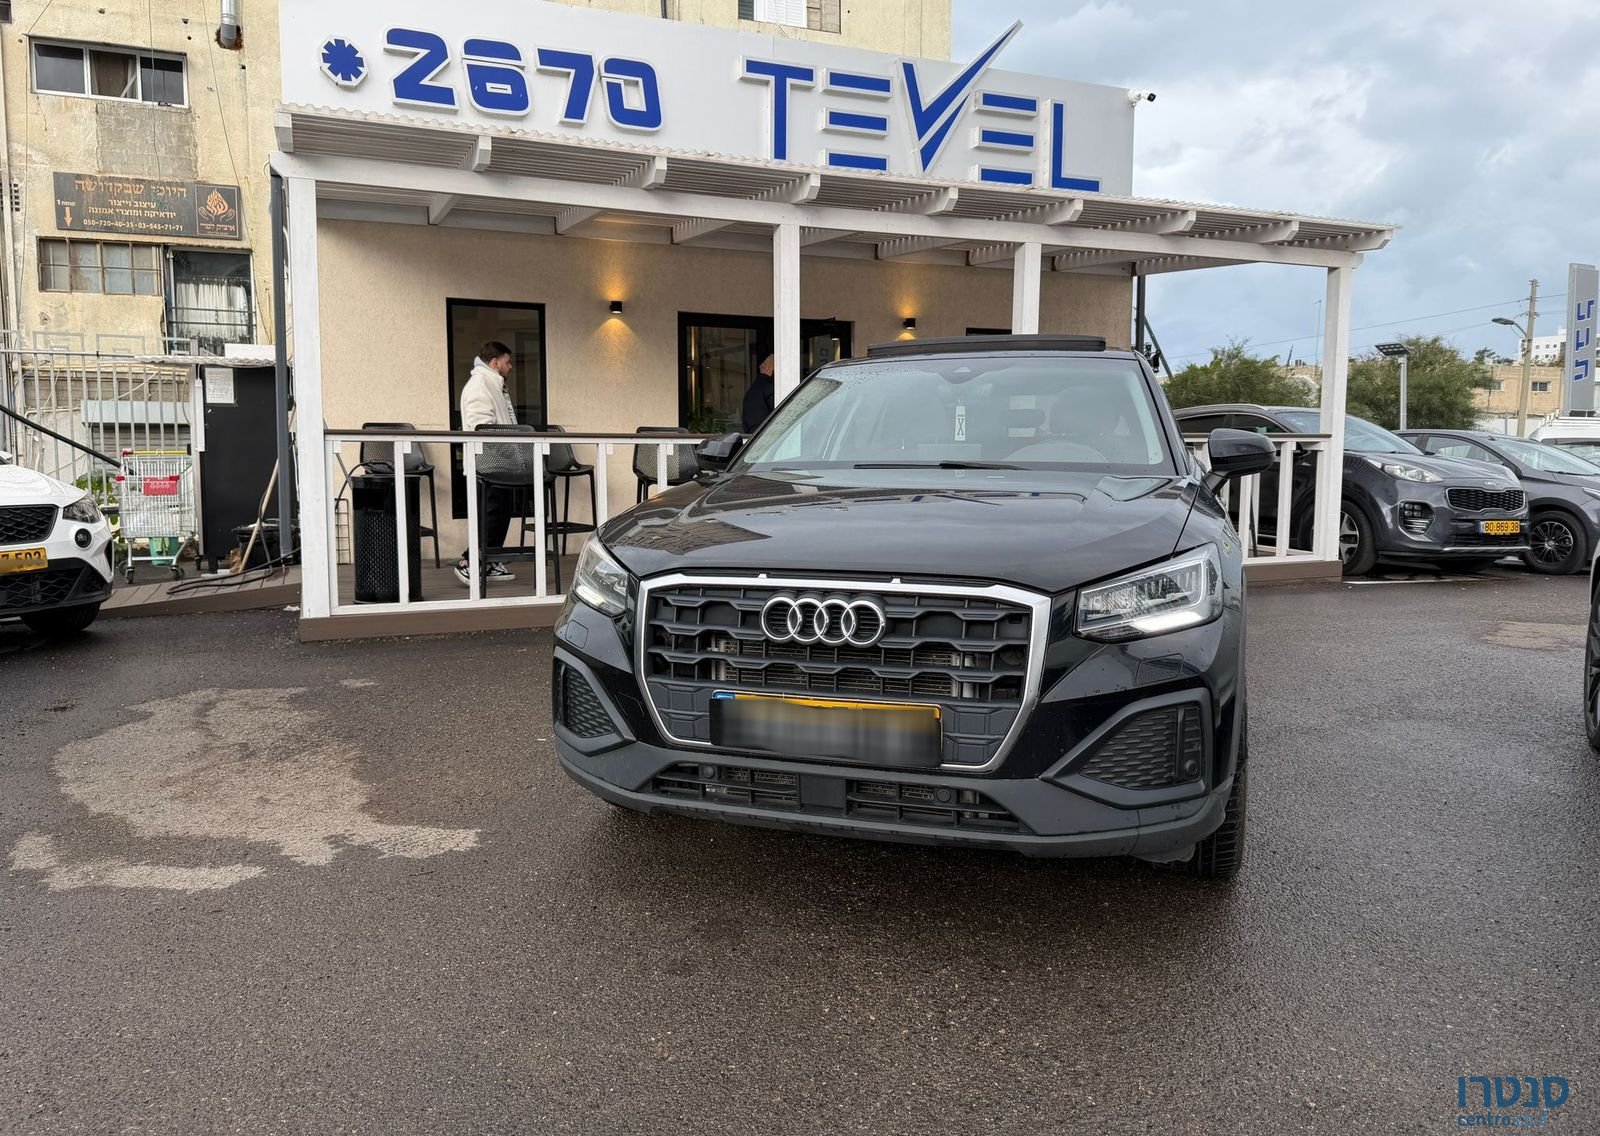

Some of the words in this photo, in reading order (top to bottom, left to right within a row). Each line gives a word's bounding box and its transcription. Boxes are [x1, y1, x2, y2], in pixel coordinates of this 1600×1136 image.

[740, 19, 1102, 193] TEVEL
[133, 200, 157, 209] עיצוב
[88, 206, 114, 215] אמונה
[115, 208, 142, 217] ומוצרי
[144, 210, 176, 219] יודאיקה
